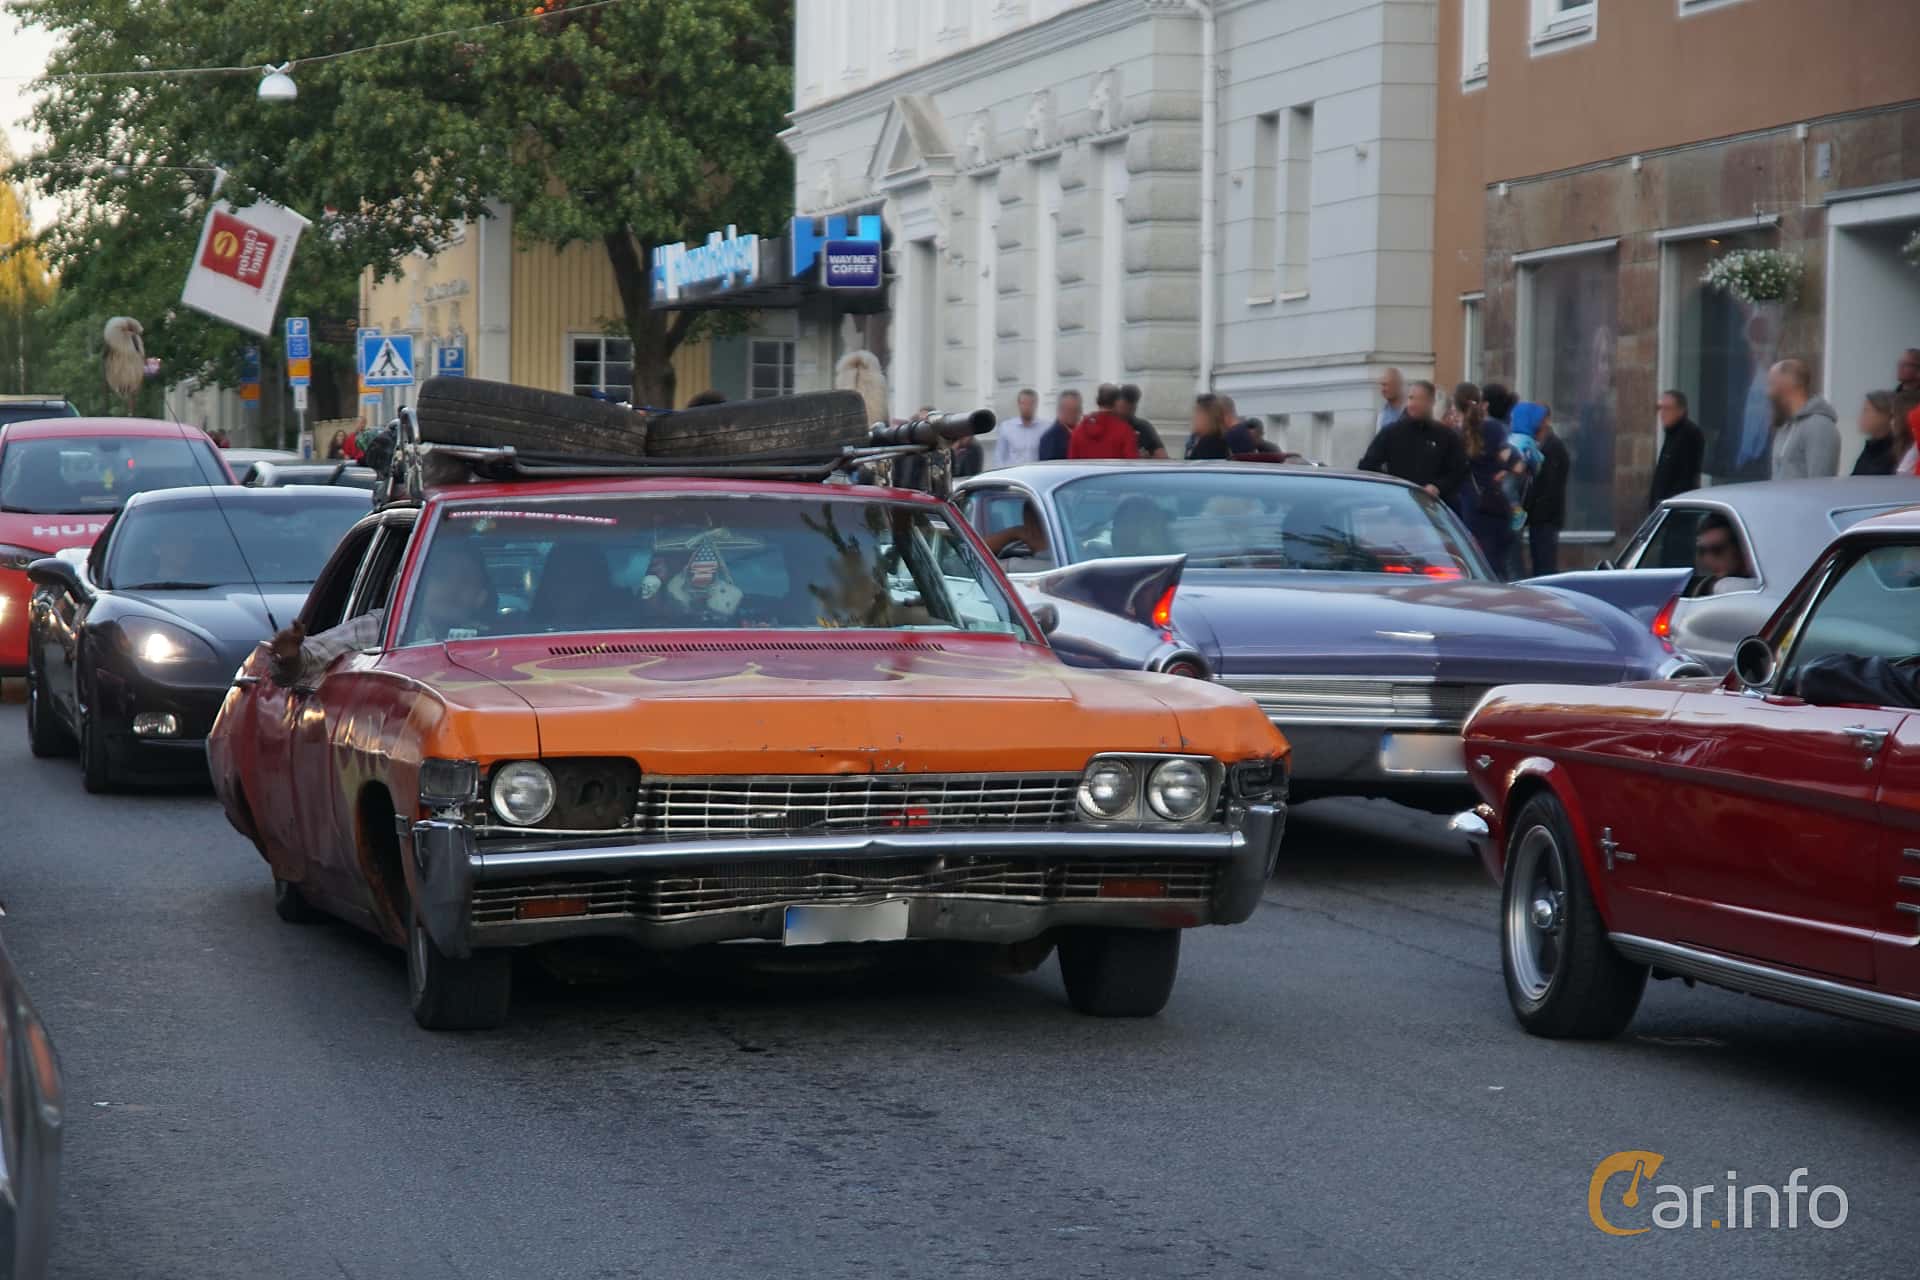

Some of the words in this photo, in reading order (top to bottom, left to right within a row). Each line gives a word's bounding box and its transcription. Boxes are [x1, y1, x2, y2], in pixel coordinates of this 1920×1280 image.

[829, 255, 877, 264] WAYNE'S
[832, 264, 874, 273] COFFEE
[445, 350, 459, 367] P
